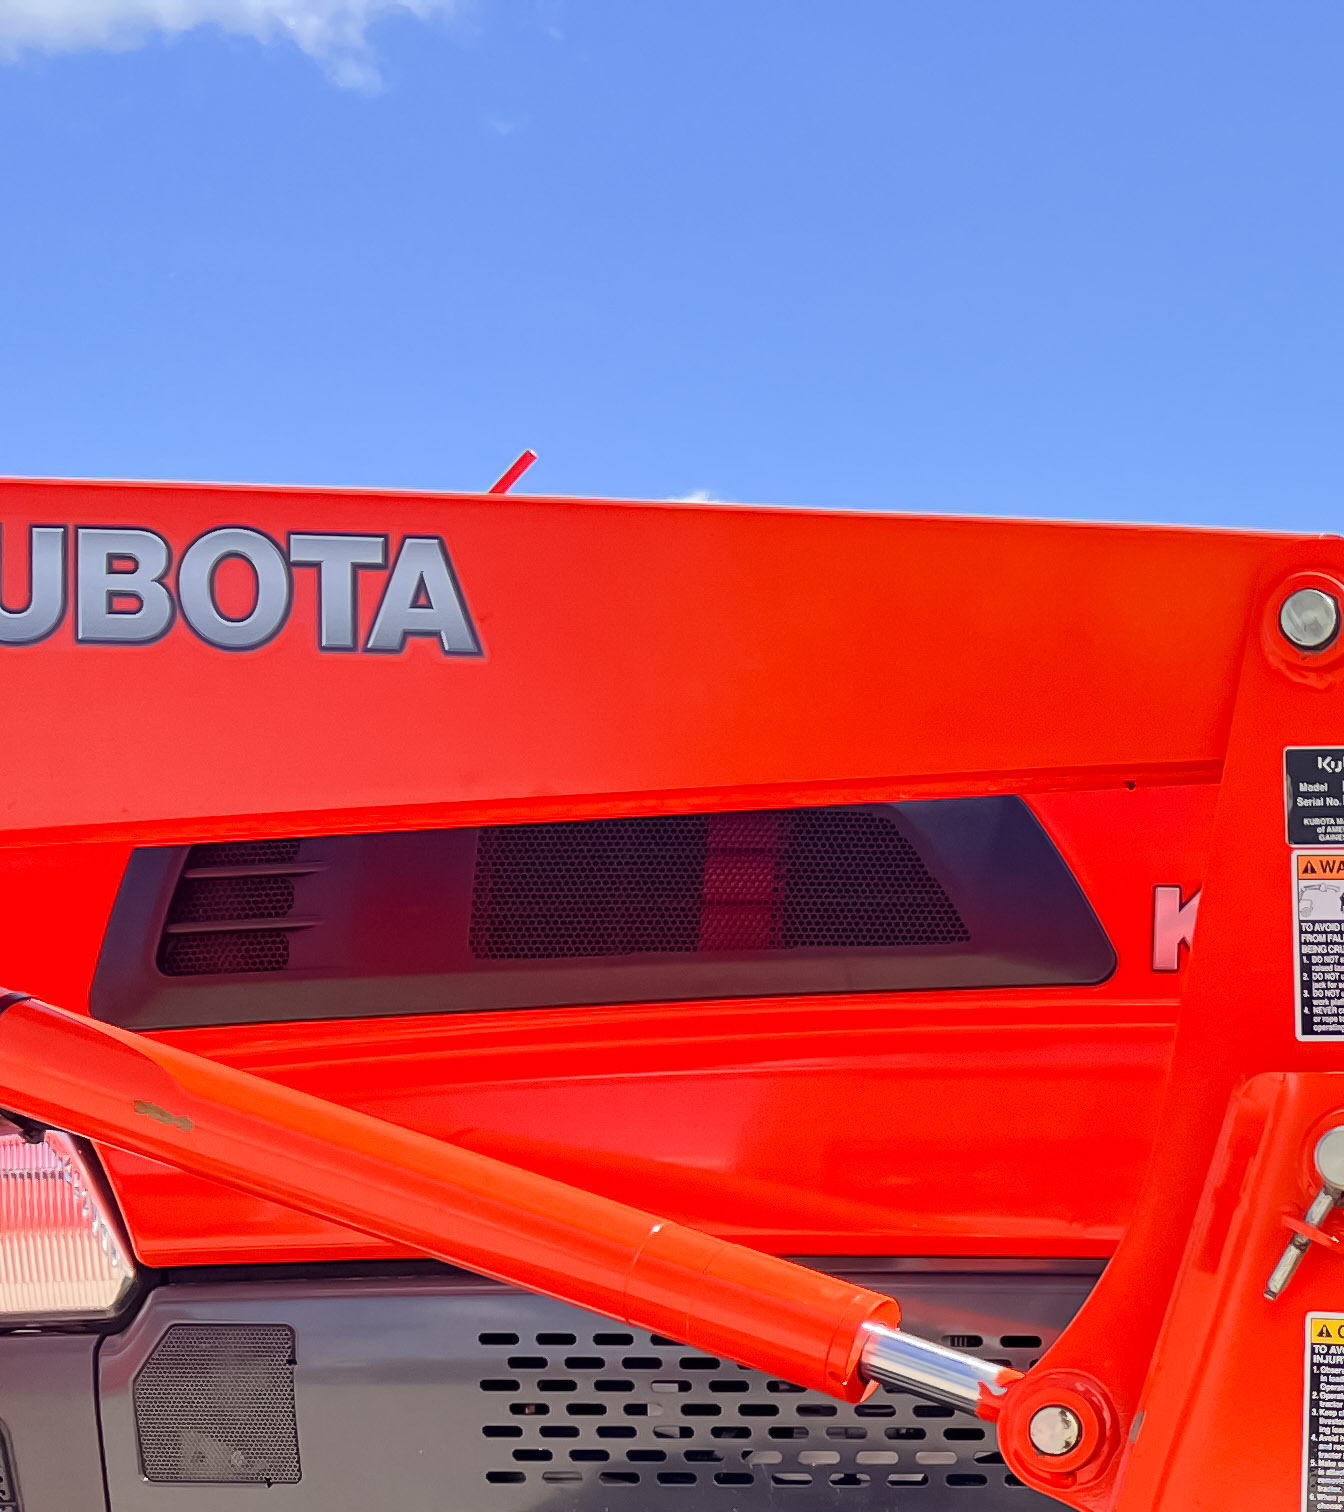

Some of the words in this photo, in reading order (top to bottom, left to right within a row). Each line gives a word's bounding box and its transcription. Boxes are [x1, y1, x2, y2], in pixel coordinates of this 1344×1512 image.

[1299, 782, 1328, 792] Model
[1297, 797, 1323, 806] Serial
[1326, 797, 1342, 806] No.
[1301, 923, 1313, 931] TO
[1314, 923, 1340, 931] AVOID
[1301, 934, 1326, 942] FROM
[1301, 945, 1327, 953] BEING
[1313, 1345, 1327, 1353] TO
